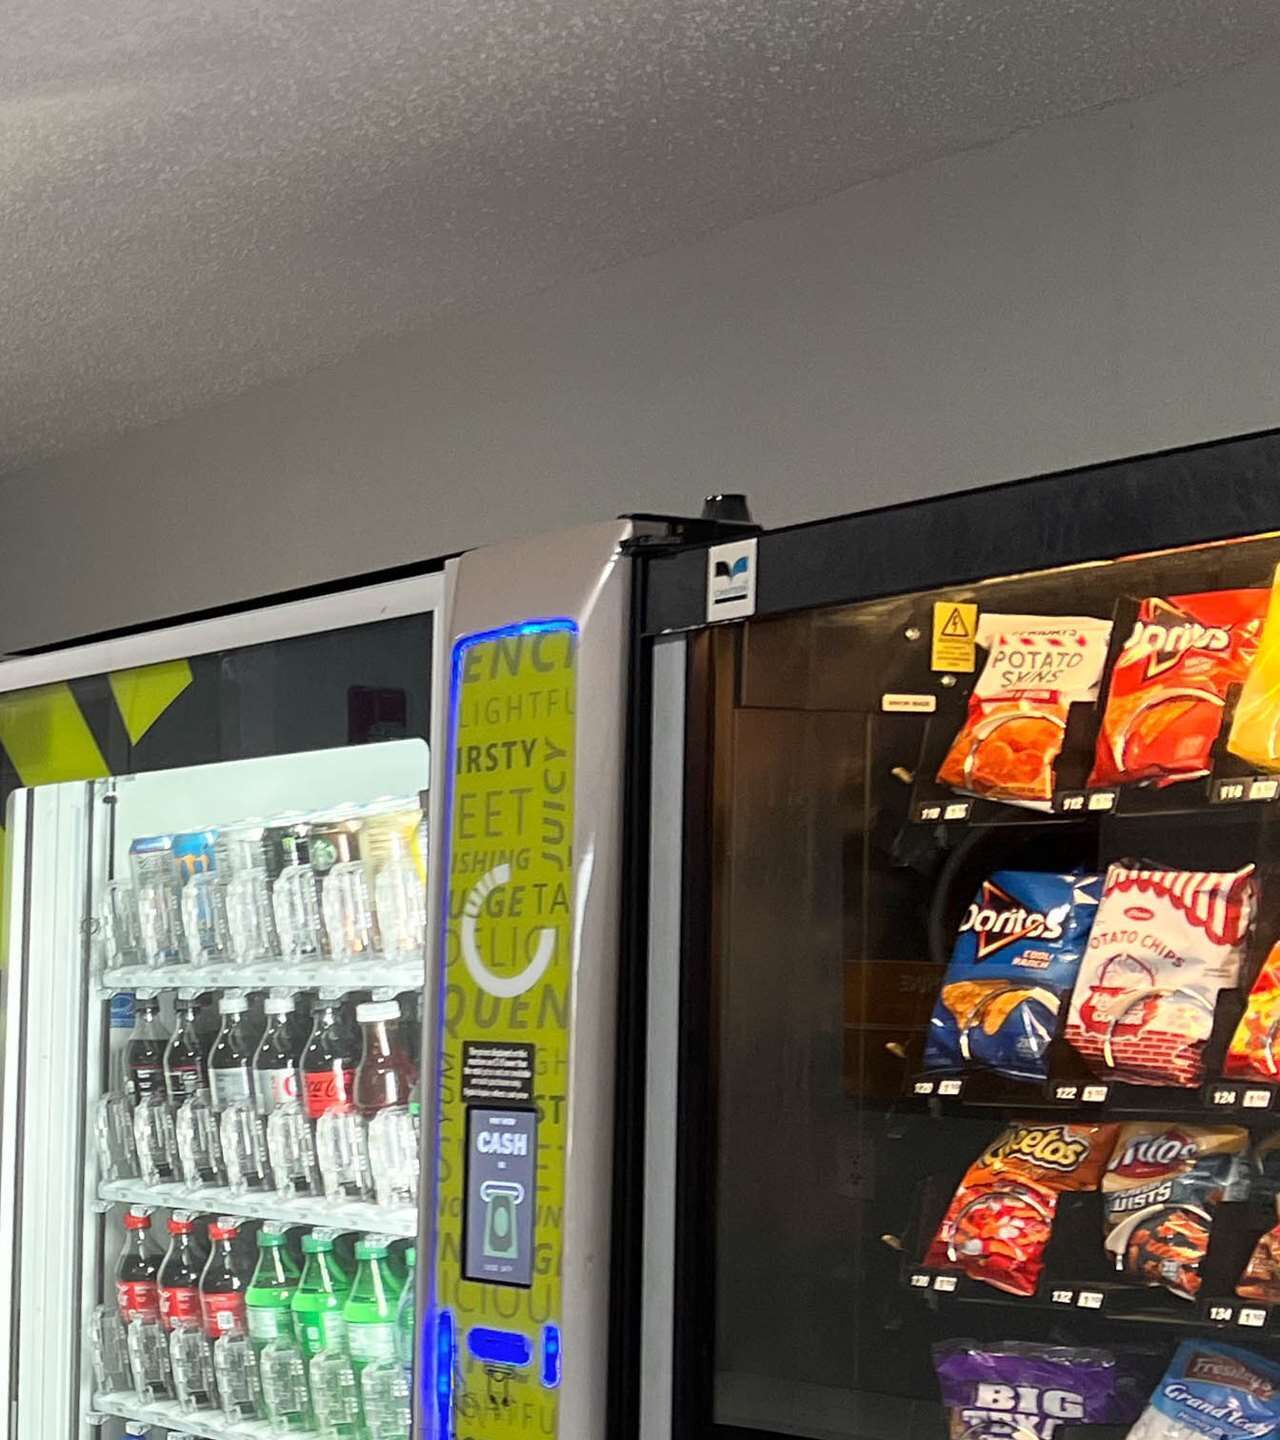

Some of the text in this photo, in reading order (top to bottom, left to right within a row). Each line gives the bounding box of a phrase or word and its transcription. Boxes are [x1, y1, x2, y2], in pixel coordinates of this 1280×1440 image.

[992, 650, 1084, 670] POTATO
[1001, 670, 1064, 689] SKINS
[541, 736, 568, 873] JUICY
[957, 903, 1071, 940] Doritos
[1090, 930, 1186, 969] OTATO CHIPS
[1055, 1086, 1078, 1100] 122
[1214, 1090, 1237, 1104] 124
[476, 1130, 529, 1157] CASH
[1208, 1307, 1232, 1321] 134
[974, 1383, 1086, 1419] BIG
[1164, 1384, 1235, 1419] Grand
